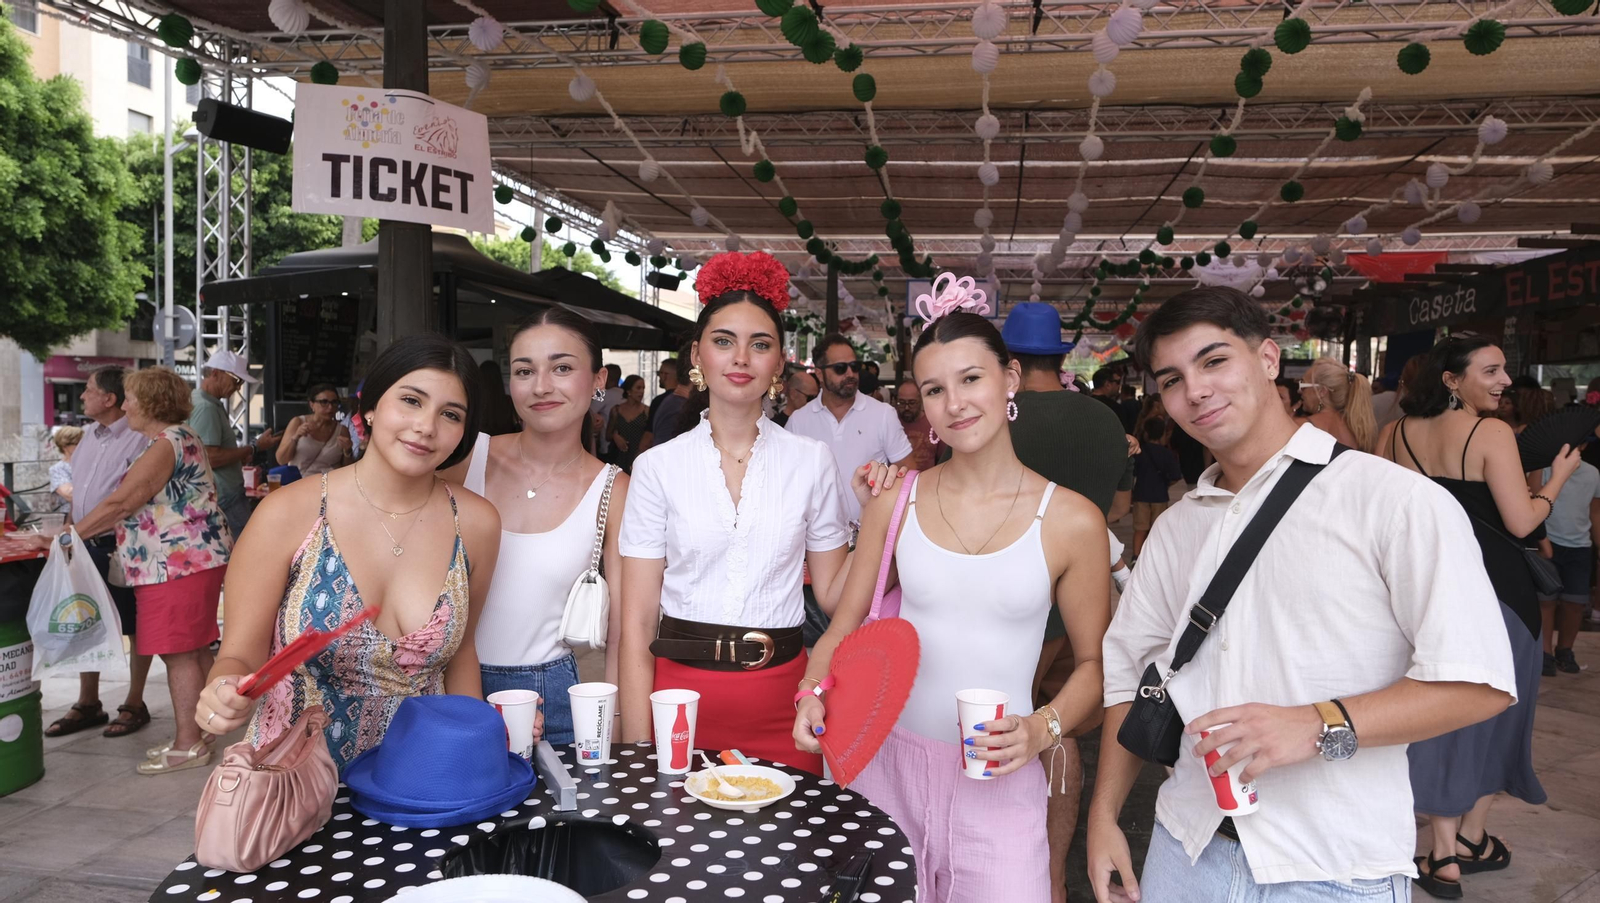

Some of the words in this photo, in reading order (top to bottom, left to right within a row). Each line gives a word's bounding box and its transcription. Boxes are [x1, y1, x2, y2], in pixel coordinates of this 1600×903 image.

[344, 125, 402, 145] Almería
[387, 110, 405, 126] de
[321, 153, 474, 214] TICKET
[1409, 284, 1476, 325] Caseta
[1505, 271, 1540, 307] EL
